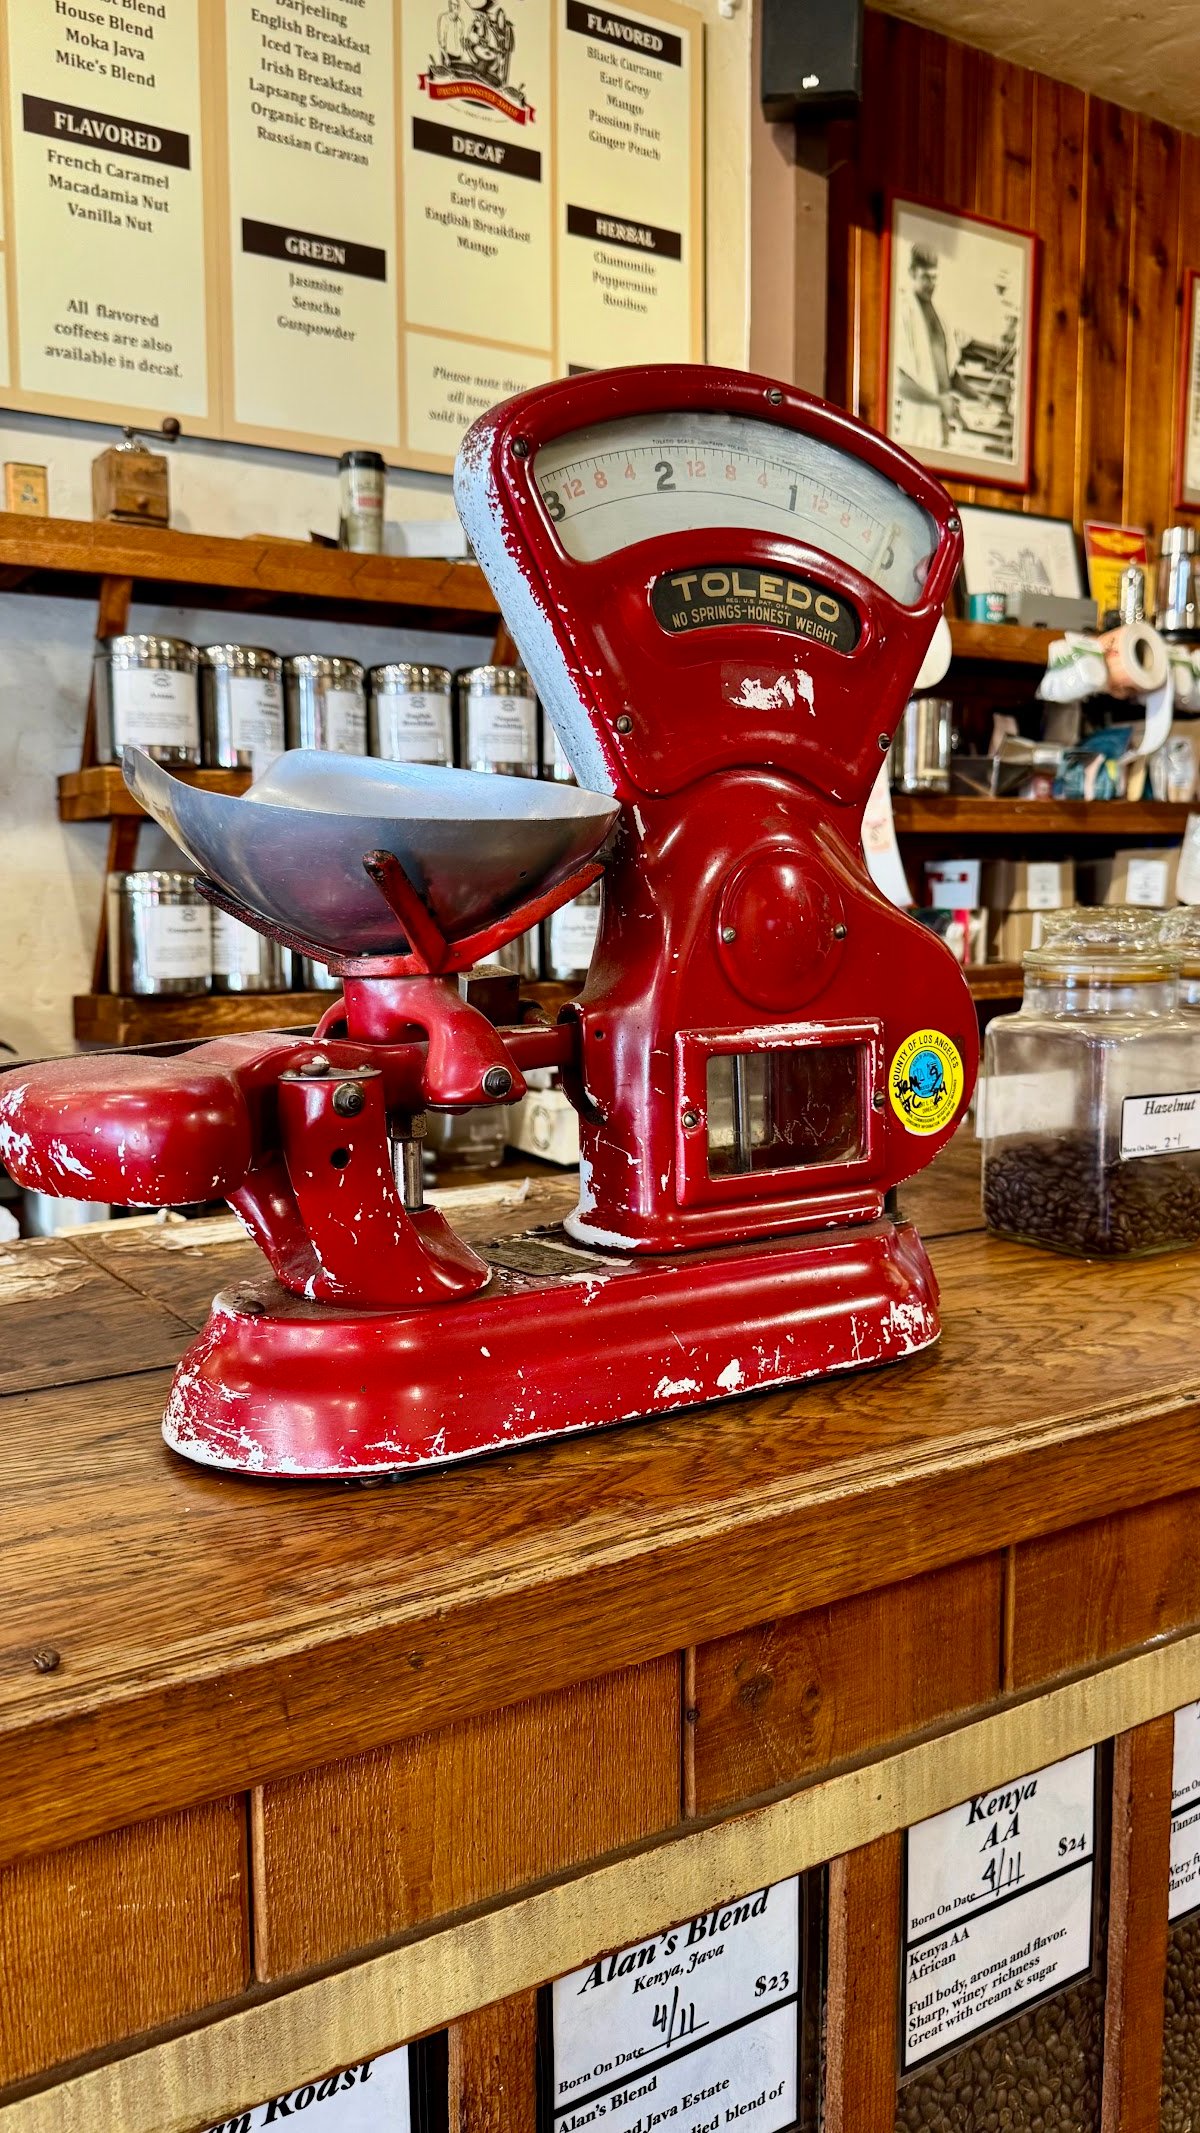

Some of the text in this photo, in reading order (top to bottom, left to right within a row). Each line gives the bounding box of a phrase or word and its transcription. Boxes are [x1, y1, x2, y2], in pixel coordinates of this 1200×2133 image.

[55, 0, 154, 39] House Blend
[122, 0, 166, 19] Blend
[65, 28, 145, 61] Moka Java
[251, 8, 371, 54] English Breakfast
[587, 13, 664, 52] FLAVORED
[55, 50, 156, 88] Mike's Blend
[261, 34, 362, 75] Iced Tea Blend
[261, 57, 363, 97] Irish Breakfast
[249, 77, 376, 127] Lapsang Souchong
[53, 110, 162, 153] FLAVORED
[251, 101, 374, 146] Organic Breakfast
[257, 125, 369, 167] Russian Caravan
[451, 135, 506, 164] DECAF
[47, 149, 170, 189] French Caramel
[48, 174, 169, 213] Macadamia Nut
[67, 202, 153, 233] Vanilla Nut
[595, 217, 656, 249] HERBAL
[284, 234, 346, 266] GREEN
[67, 299, 160, 328] All flavored
[276, 315, 356, 342] Gunpowder
[54, 321, 173, 353] coffees are also
[44, 344, 117, 367] available
[119, 356, 136, 371] in
[562, 478, 585, 500] 12
[594, 471, 609, 489] 8
[624, 464, 637, 481] 4
[654, 461, 677, 492] 2
[686, 460, 707, 478] 12
[725, 465, 737, 482] 8
[758, 472, 768, 489] 4
[788, 485, 799, 512] 1
[811, 494, 829, 515] 12
[840, 511, 852, 528] 8
[670, 571, 841, 623] TOLEDO
[672, 604, 839, 647] NO SPRINGS-HONEST WEIGHT
[907, 1040, 917, 1051] OF
[919, 1034, 933, 1045] LOS
[934, 1036, 959, 1069] ANGELES
[1143, 1097, 1196, 1116] Hazelnut
[965, 1779, 1038, 1827] Kenya
[1057, 1832, 1087, 1857] $24
[982, 1847, 1022, 1897] 4/11
[1168, 1871, 1196, 1891] flavor
[1169, 1859, 1192, 1876] Very
[910, 1891, 976, 1930] Born On Date
[577, 1886, 770, 1996] Alan's Blend
[908, 1927, 971, 1969] Kenya AA
[632, 1943, 725, 1995] Kenya, Java
[754, 1970, 791, 1998] $23
[908, 1952, 957, 1984] African
[908, 1927, 1069, 2018] Full body, aroma and flavor.
[908, 1956, 1041, 2033] Sharp, winey richness
[908, 1960, 1058, 2049] Great with cream & sugar
[652, 1986, 695, 2048] 4/11
[558, 2046, 645, 2095] Born On Date
[261, 2058, 376, 2127] Roast
[558, 2103, 607, 2133] Alan's
[609, 2076, 659, 2113] Blend
[642, 2105, 679, 2132] Java
[681, 2078, 731, 2111] Estate
[726, 2080, 786, 2123] blend of
